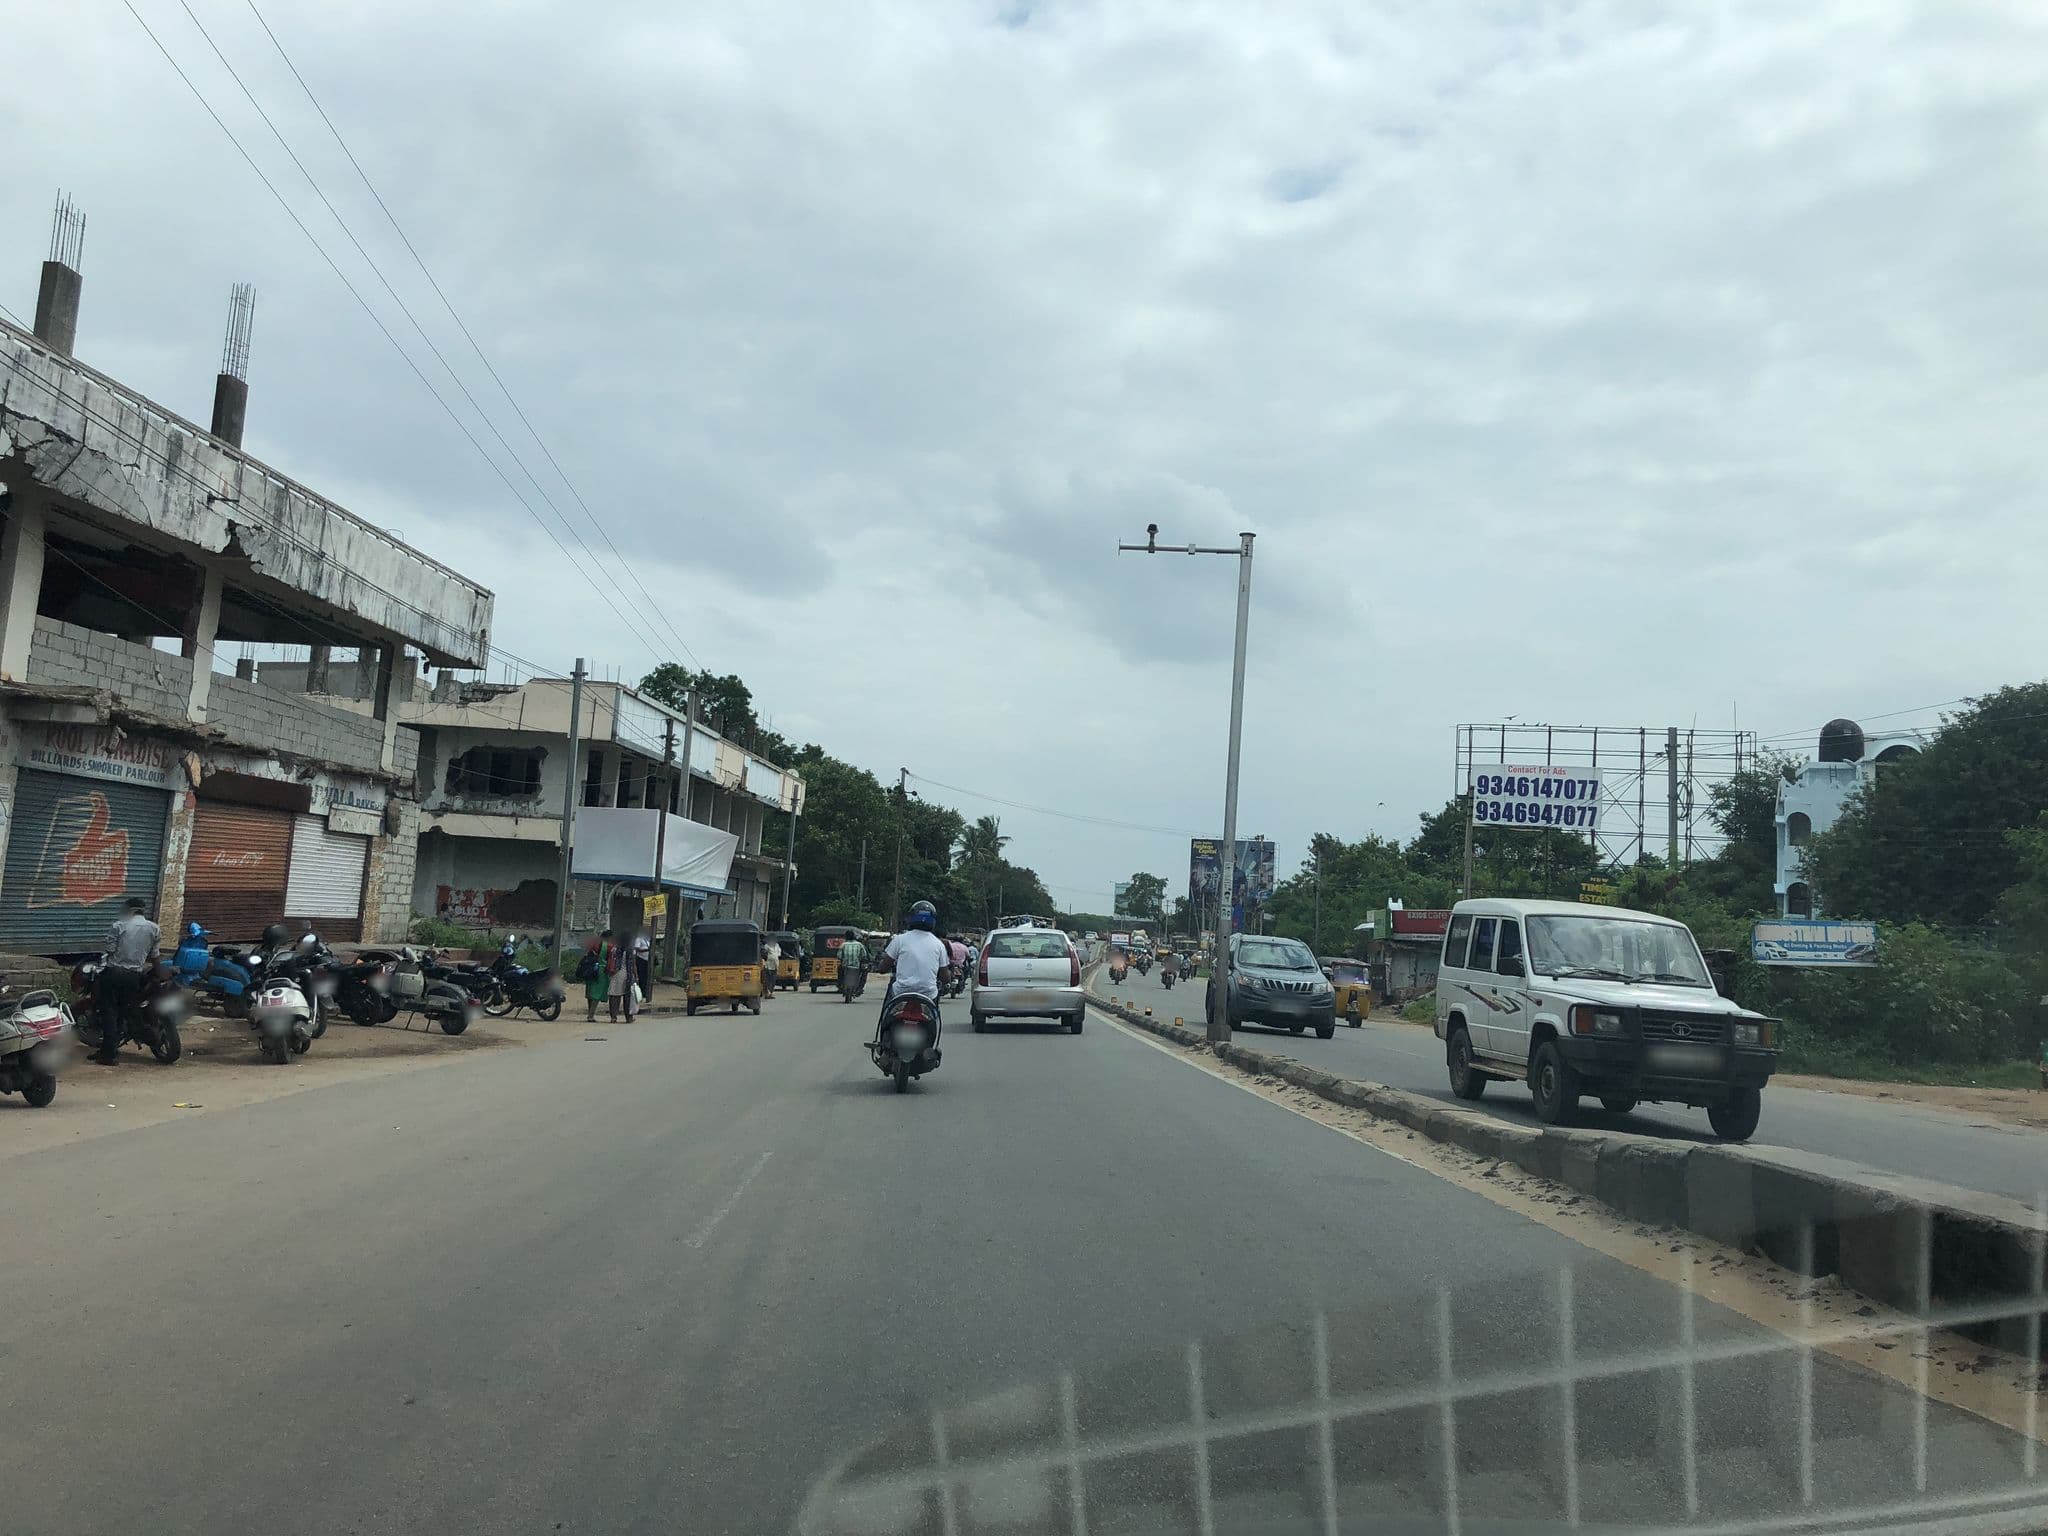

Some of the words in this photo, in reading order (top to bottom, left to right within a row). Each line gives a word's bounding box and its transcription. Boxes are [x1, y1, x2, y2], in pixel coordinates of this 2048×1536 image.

[31, 750, 81, 769] BILLIARDS
[87, 760, 123, 777] SNOOKER
[125, 767, 166, 783] PARLOUR
[1508, 765, 1537, 774] Contact
[1539, 766, 1550, 774] For
[1553, 767, 1567, 775] Ads
[1477, 775, 1599, 800] 9346147077
[1476, 801, 1598, 826] 9346947077
[1408, 912, 1427, 920] EXIDE
[1428, 912, 1448, 920] care
